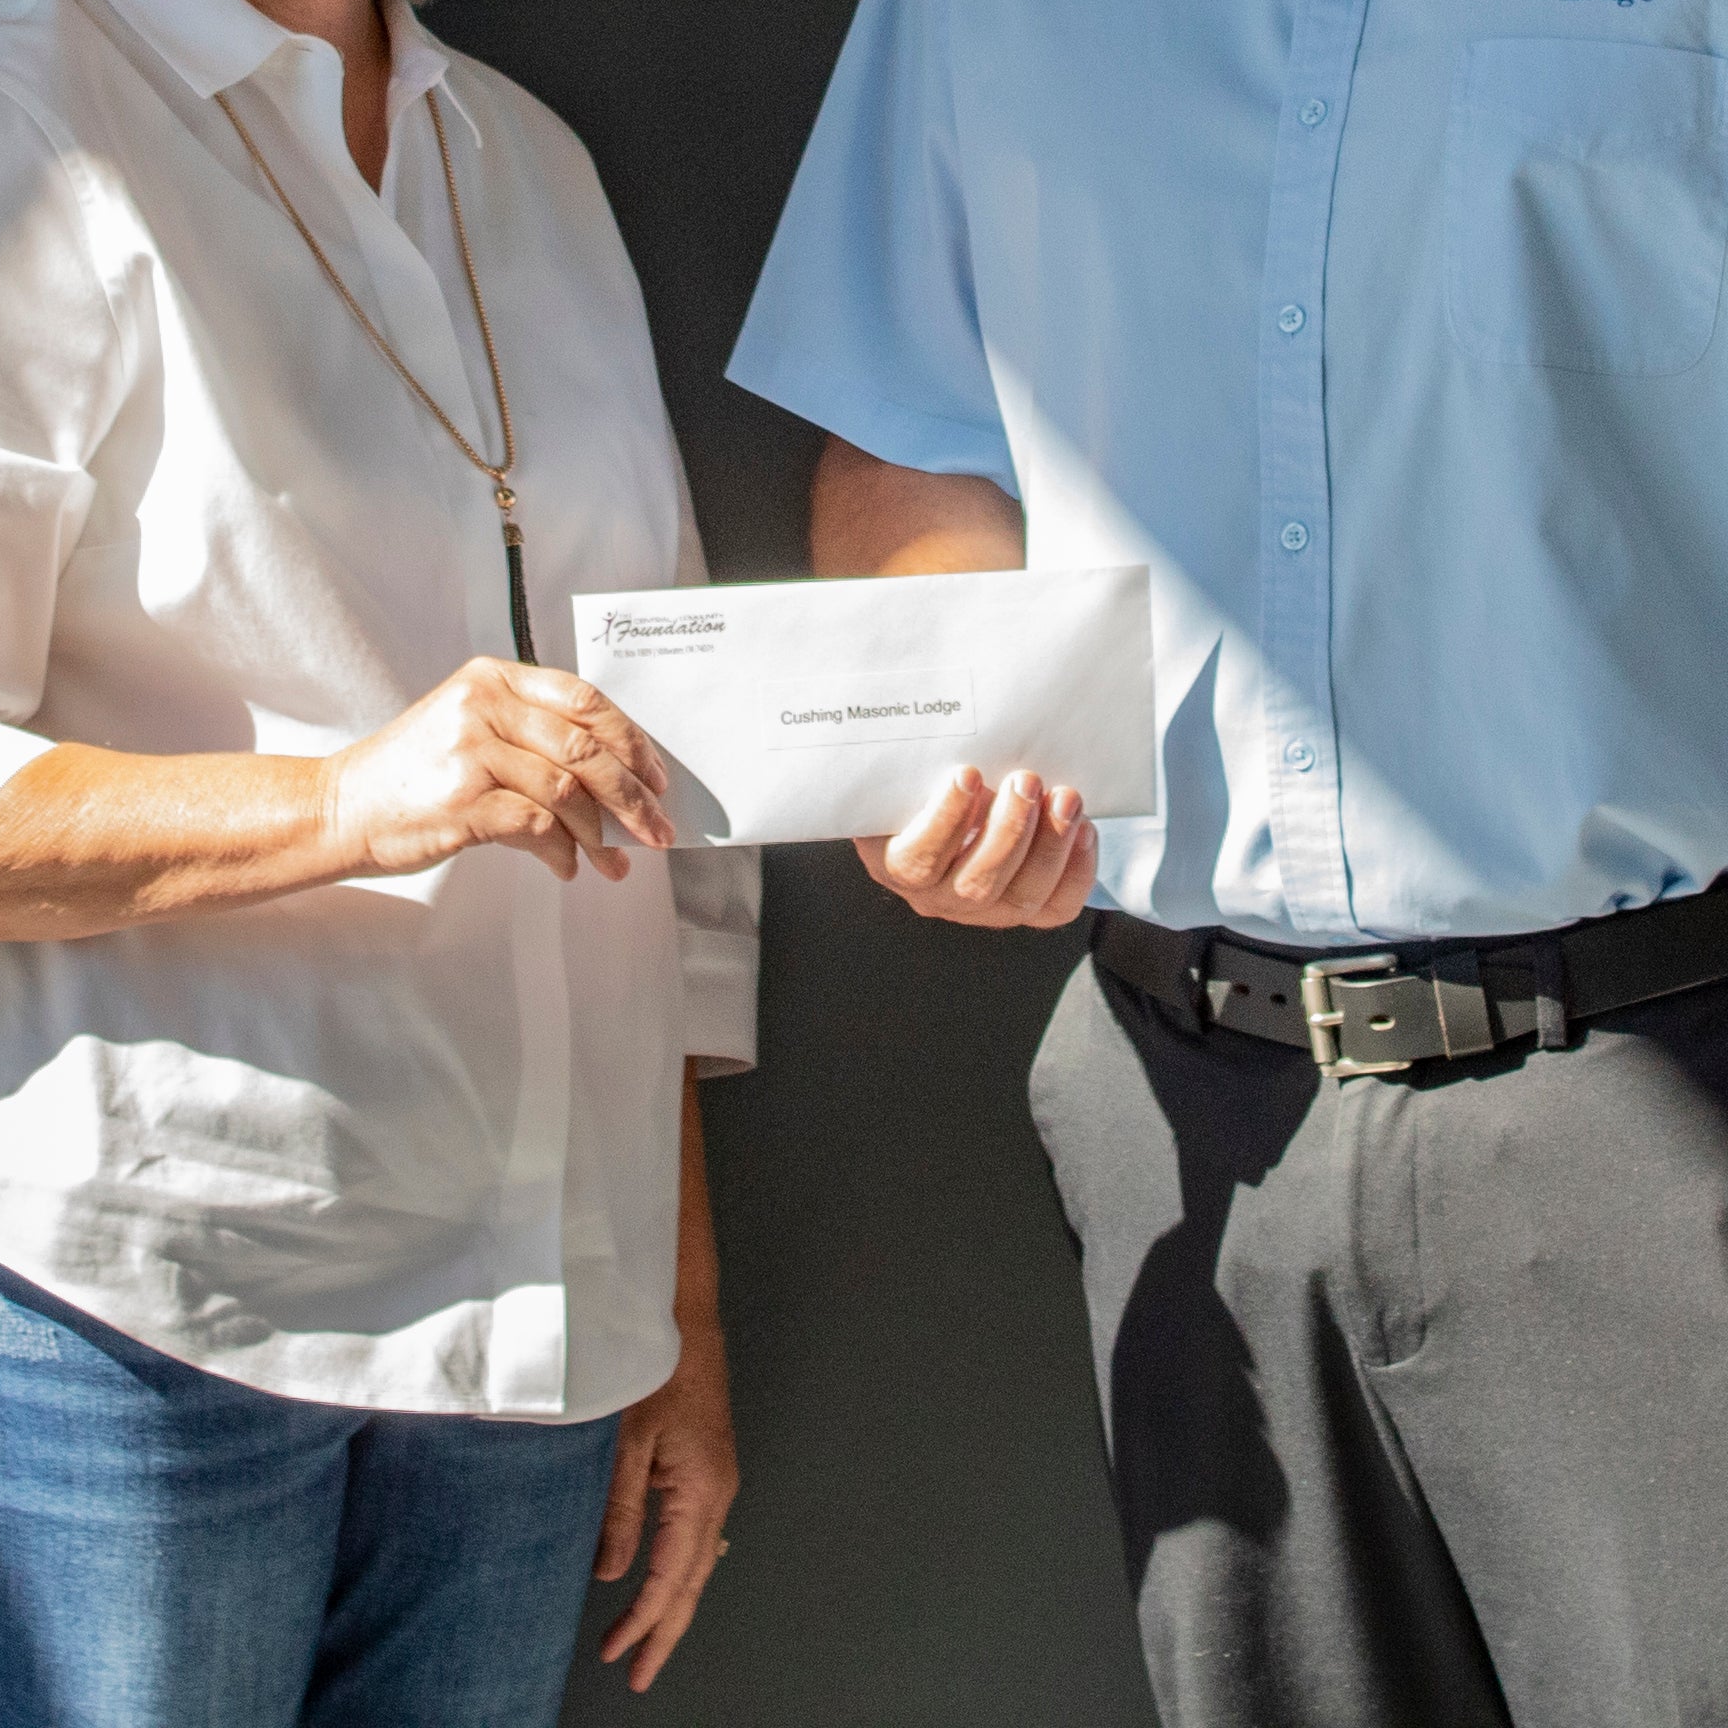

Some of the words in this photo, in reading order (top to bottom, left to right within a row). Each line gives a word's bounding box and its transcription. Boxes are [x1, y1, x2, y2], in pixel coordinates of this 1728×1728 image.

[613, 619, 726, 643] Foundation
[780, 708, 843, 725] Cushing
[847, 702, 910, 720] Masonic
[914, 699, 962, 715] Lodge
